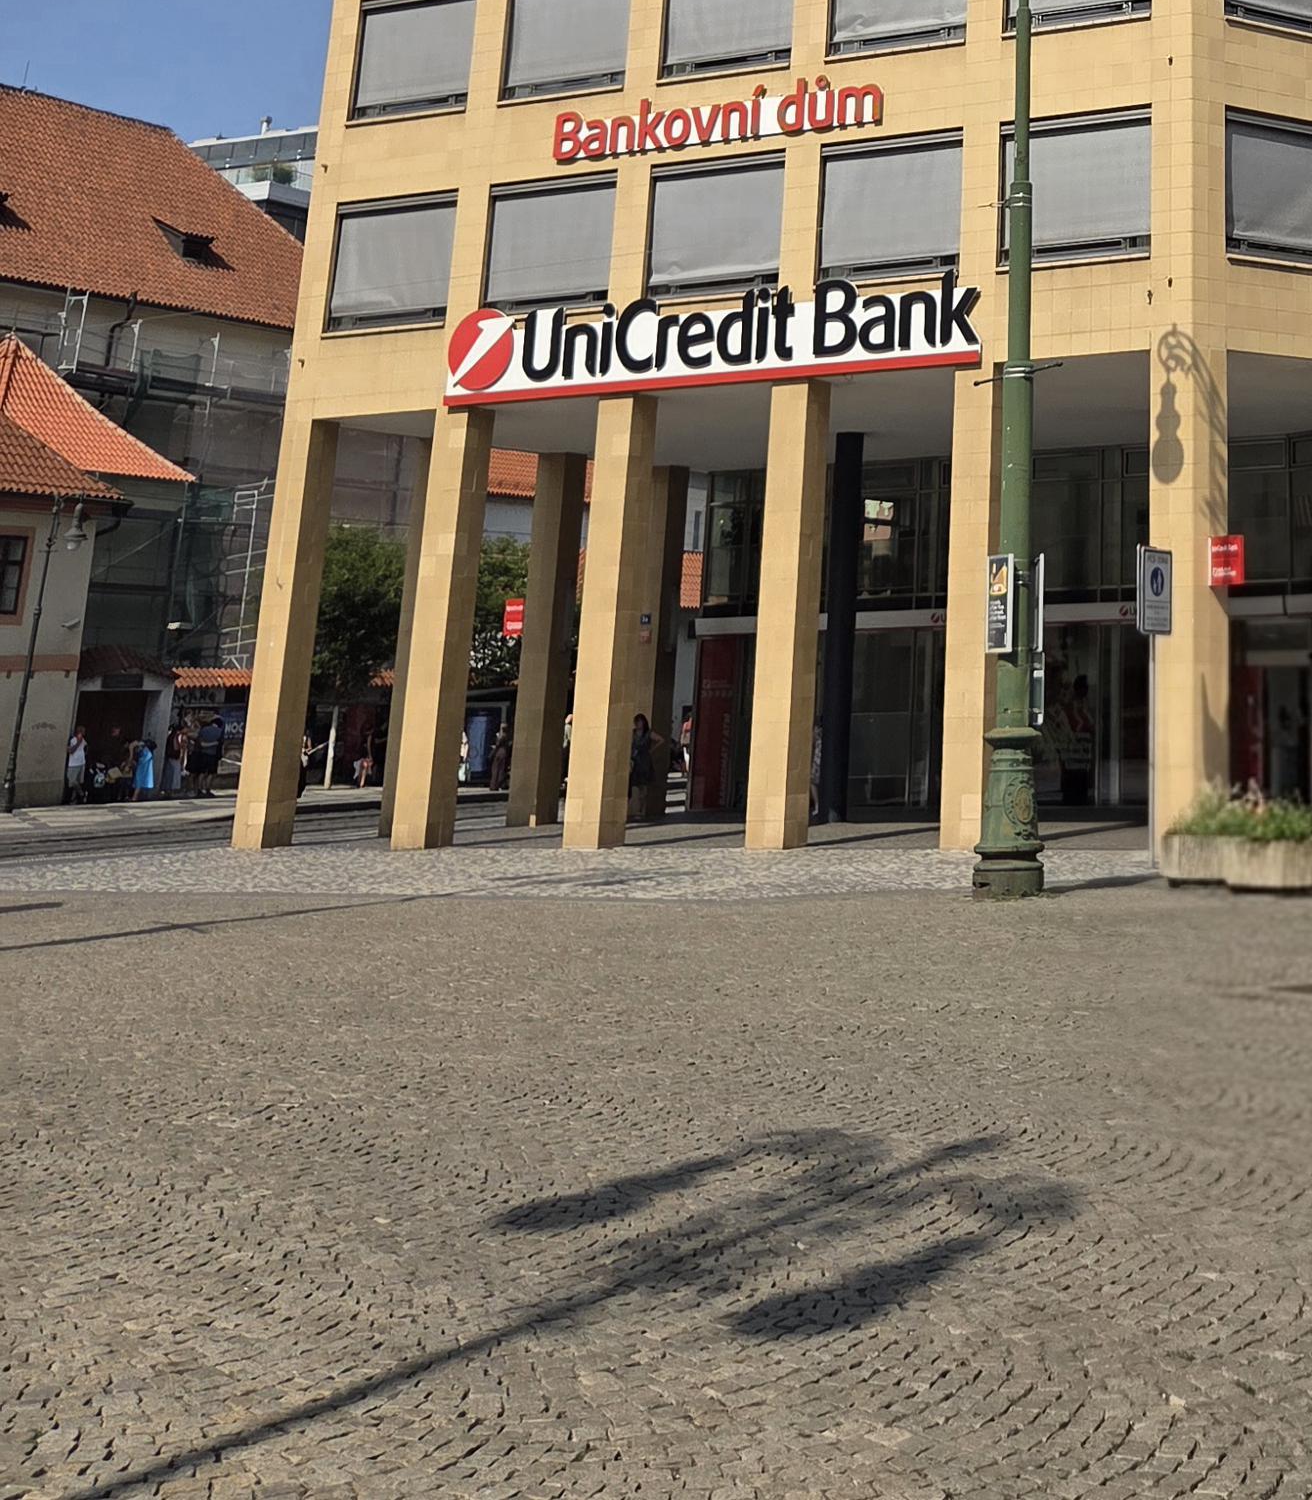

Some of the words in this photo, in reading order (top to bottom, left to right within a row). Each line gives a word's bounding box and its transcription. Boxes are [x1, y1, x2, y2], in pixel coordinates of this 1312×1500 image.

[552, 84, 766, 162] Bankovní
[776, 75, 883, 136] dům
[521, 283, 796, 382] UniCredit
[813, 268, 980, 357] Bank
